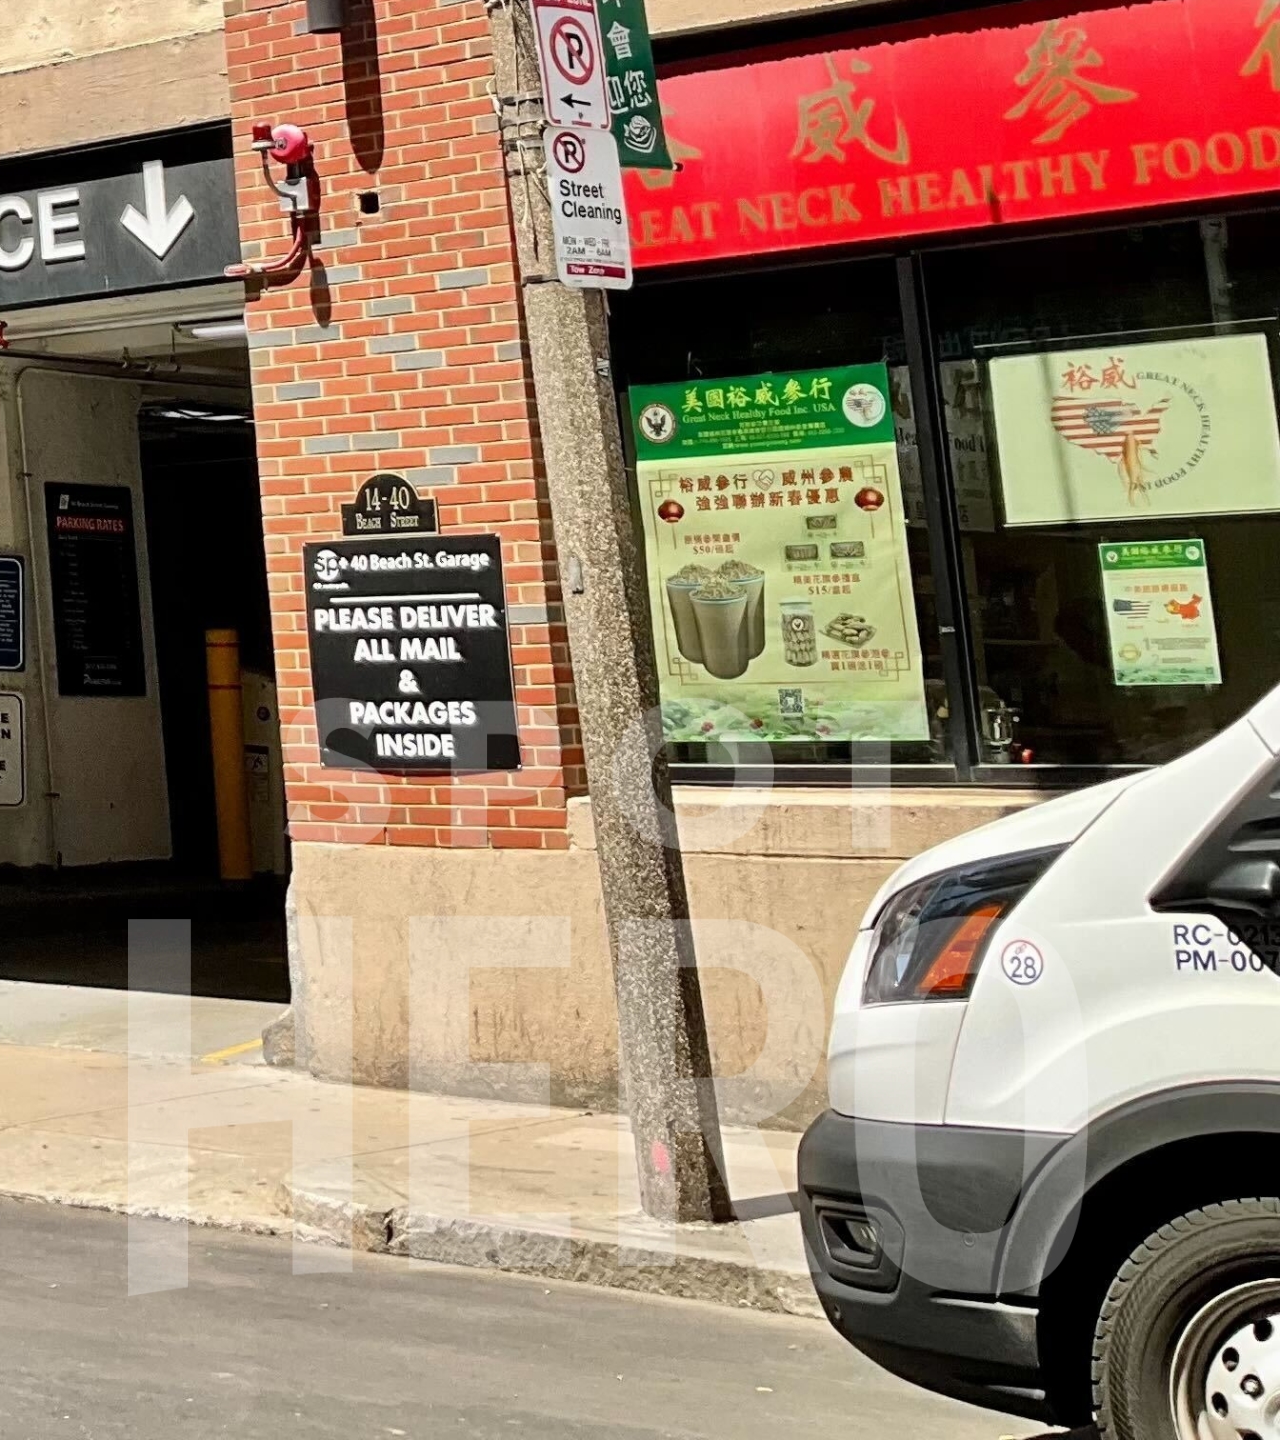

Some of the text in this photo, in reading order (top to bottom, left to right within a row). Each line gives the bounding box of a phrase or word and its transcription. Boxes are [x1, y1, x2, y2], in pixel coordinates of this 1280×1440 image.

[560, 178, 605, 200] Street
[737, 181, 863, 235] NECK
[878, 150, 1112, 219] HEALTHY
[561, 200, 622, 225] Cleaning
[566, 246, 586, 255] 2AM
[1061, 356, 1137, 391] 裕威
[1136, 370, 1179, 387] GREAT
[681, 377, 833, 412] 美國裕威參行
[1180, 381, 1205, 413] NECK
[682, 402, 836, 424] Great Neck Healthy Food USA
[1185, 414, 1211, 470] HEALTHY
[56, 516, 124, 532] PARKING RATES
[351, 555, 367, 571] 40
[371, 552, 412, 571] Beach
[414, 551, 434, 570] St.
[435, 550, 491, 571] Garage
[314, 604, 498, 631] PLEASE DELIVER
[354, 637, 461, 661] ALL MAIL
[397, 669, 421, 693] &
[349, 701, 477, 726] PACKAGES
[375, 733, 455, 758] INSIDE
[1010, 956, 1037, 979] 28
